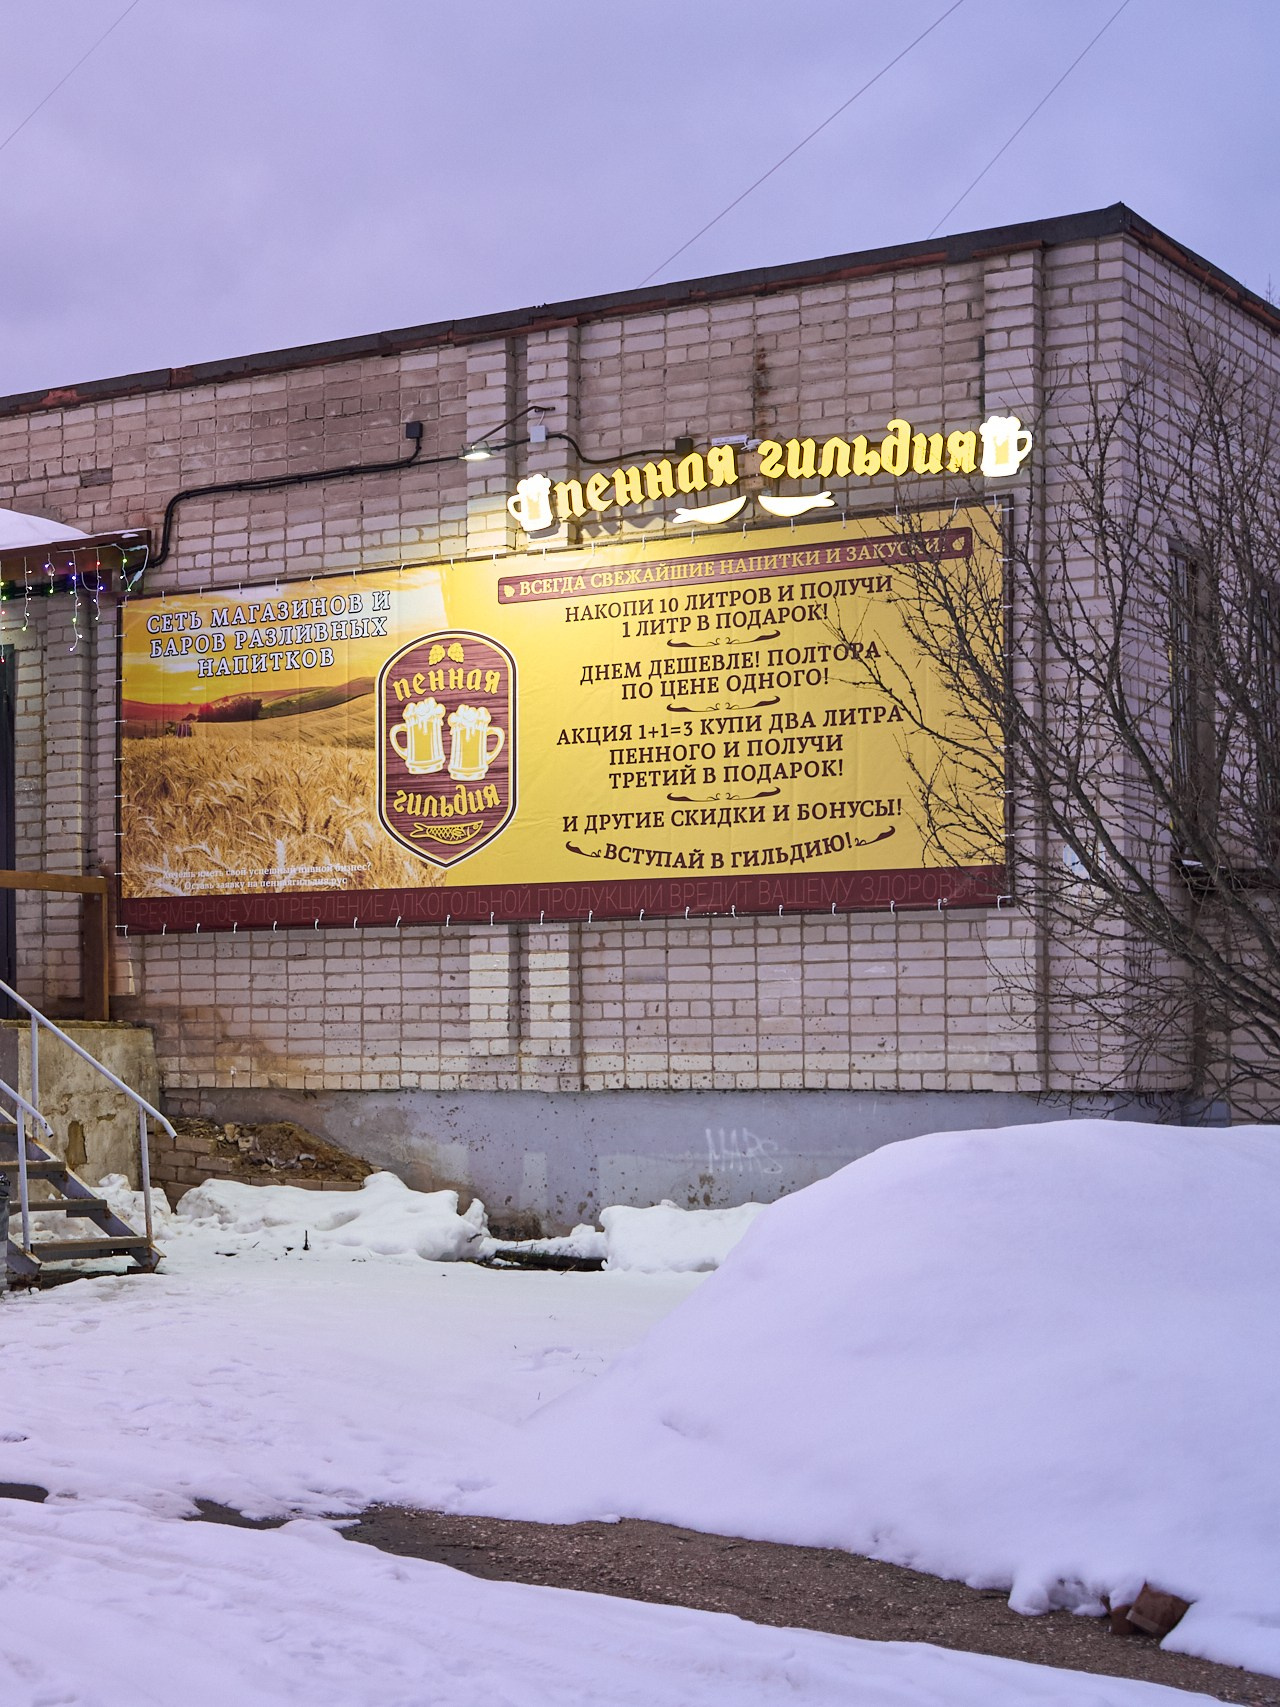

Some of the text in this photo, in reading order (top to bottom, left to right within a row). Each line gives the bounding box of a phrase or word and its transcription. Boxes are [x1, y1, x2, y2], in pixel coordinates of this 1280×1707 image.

[554, 419, 978, 518] пенная гильдия
[519, 576, 586, 597] ВСЕГДА
[590, 562, 715, 589] СВЕЖАЙШИЕ
[719, 550, 821, 576] НАПИТКИ
[826, 548, 841, 564] И
[146, 590, 391, 634] СЕТЬ МАГАЗИНОВ И
[565, 575, 894, 622] НАКОПИ 10 ЛИТРОВ И ПОЛУЧИ
[150, 616, 388, 658] БАРОВ РАЗЛИВНЫХ
[622, 603, 829, 638] 1 ЛИТР В ПОДАРОК!
[197, 647, 336, 678] НАПИТКОВ
[580, 640, 881, 686] ДНЕМ ДЕШЕВЛЕ! ПОЛТОРА
[391, 665, 501, 702] пенная
[622, 667, 829, 700] ПО ЦЕНЕ ОДНОГО!
[556, 704, 904, 746] АКЦИЯ 1+1=3 КУПИ ДВА ЛИТРА
[609, 733, 844, 766] ПЕННОГО И ПОЛУЧИ
[609, 758, 844, 790] ТРЕТИЙ В ПОДАРОК!
[392, 782, 503, 818] гильдия
[563, 797, 903, 833] И ДРУГИЕ СКИДКИ И БОНУСЫ!
[603, 832, 853, 870] ВСТУПАЙ В ГИЛЬДИЮ!
[128, 898, 239, 926] ЧРЕЗМЕРНОЕ
[244, 894, 384, 922] УПОТРЕБЛЕНИЕ
[394, 884, 531, 918] АЛКОГОЛЬНОЙ
[538, 883, 664, 914] ПРОДУКЦИИ
[670, 880, 753, 908] ВРЕДИТ
[758, 876, 856, 905] ВАШЕМУ
